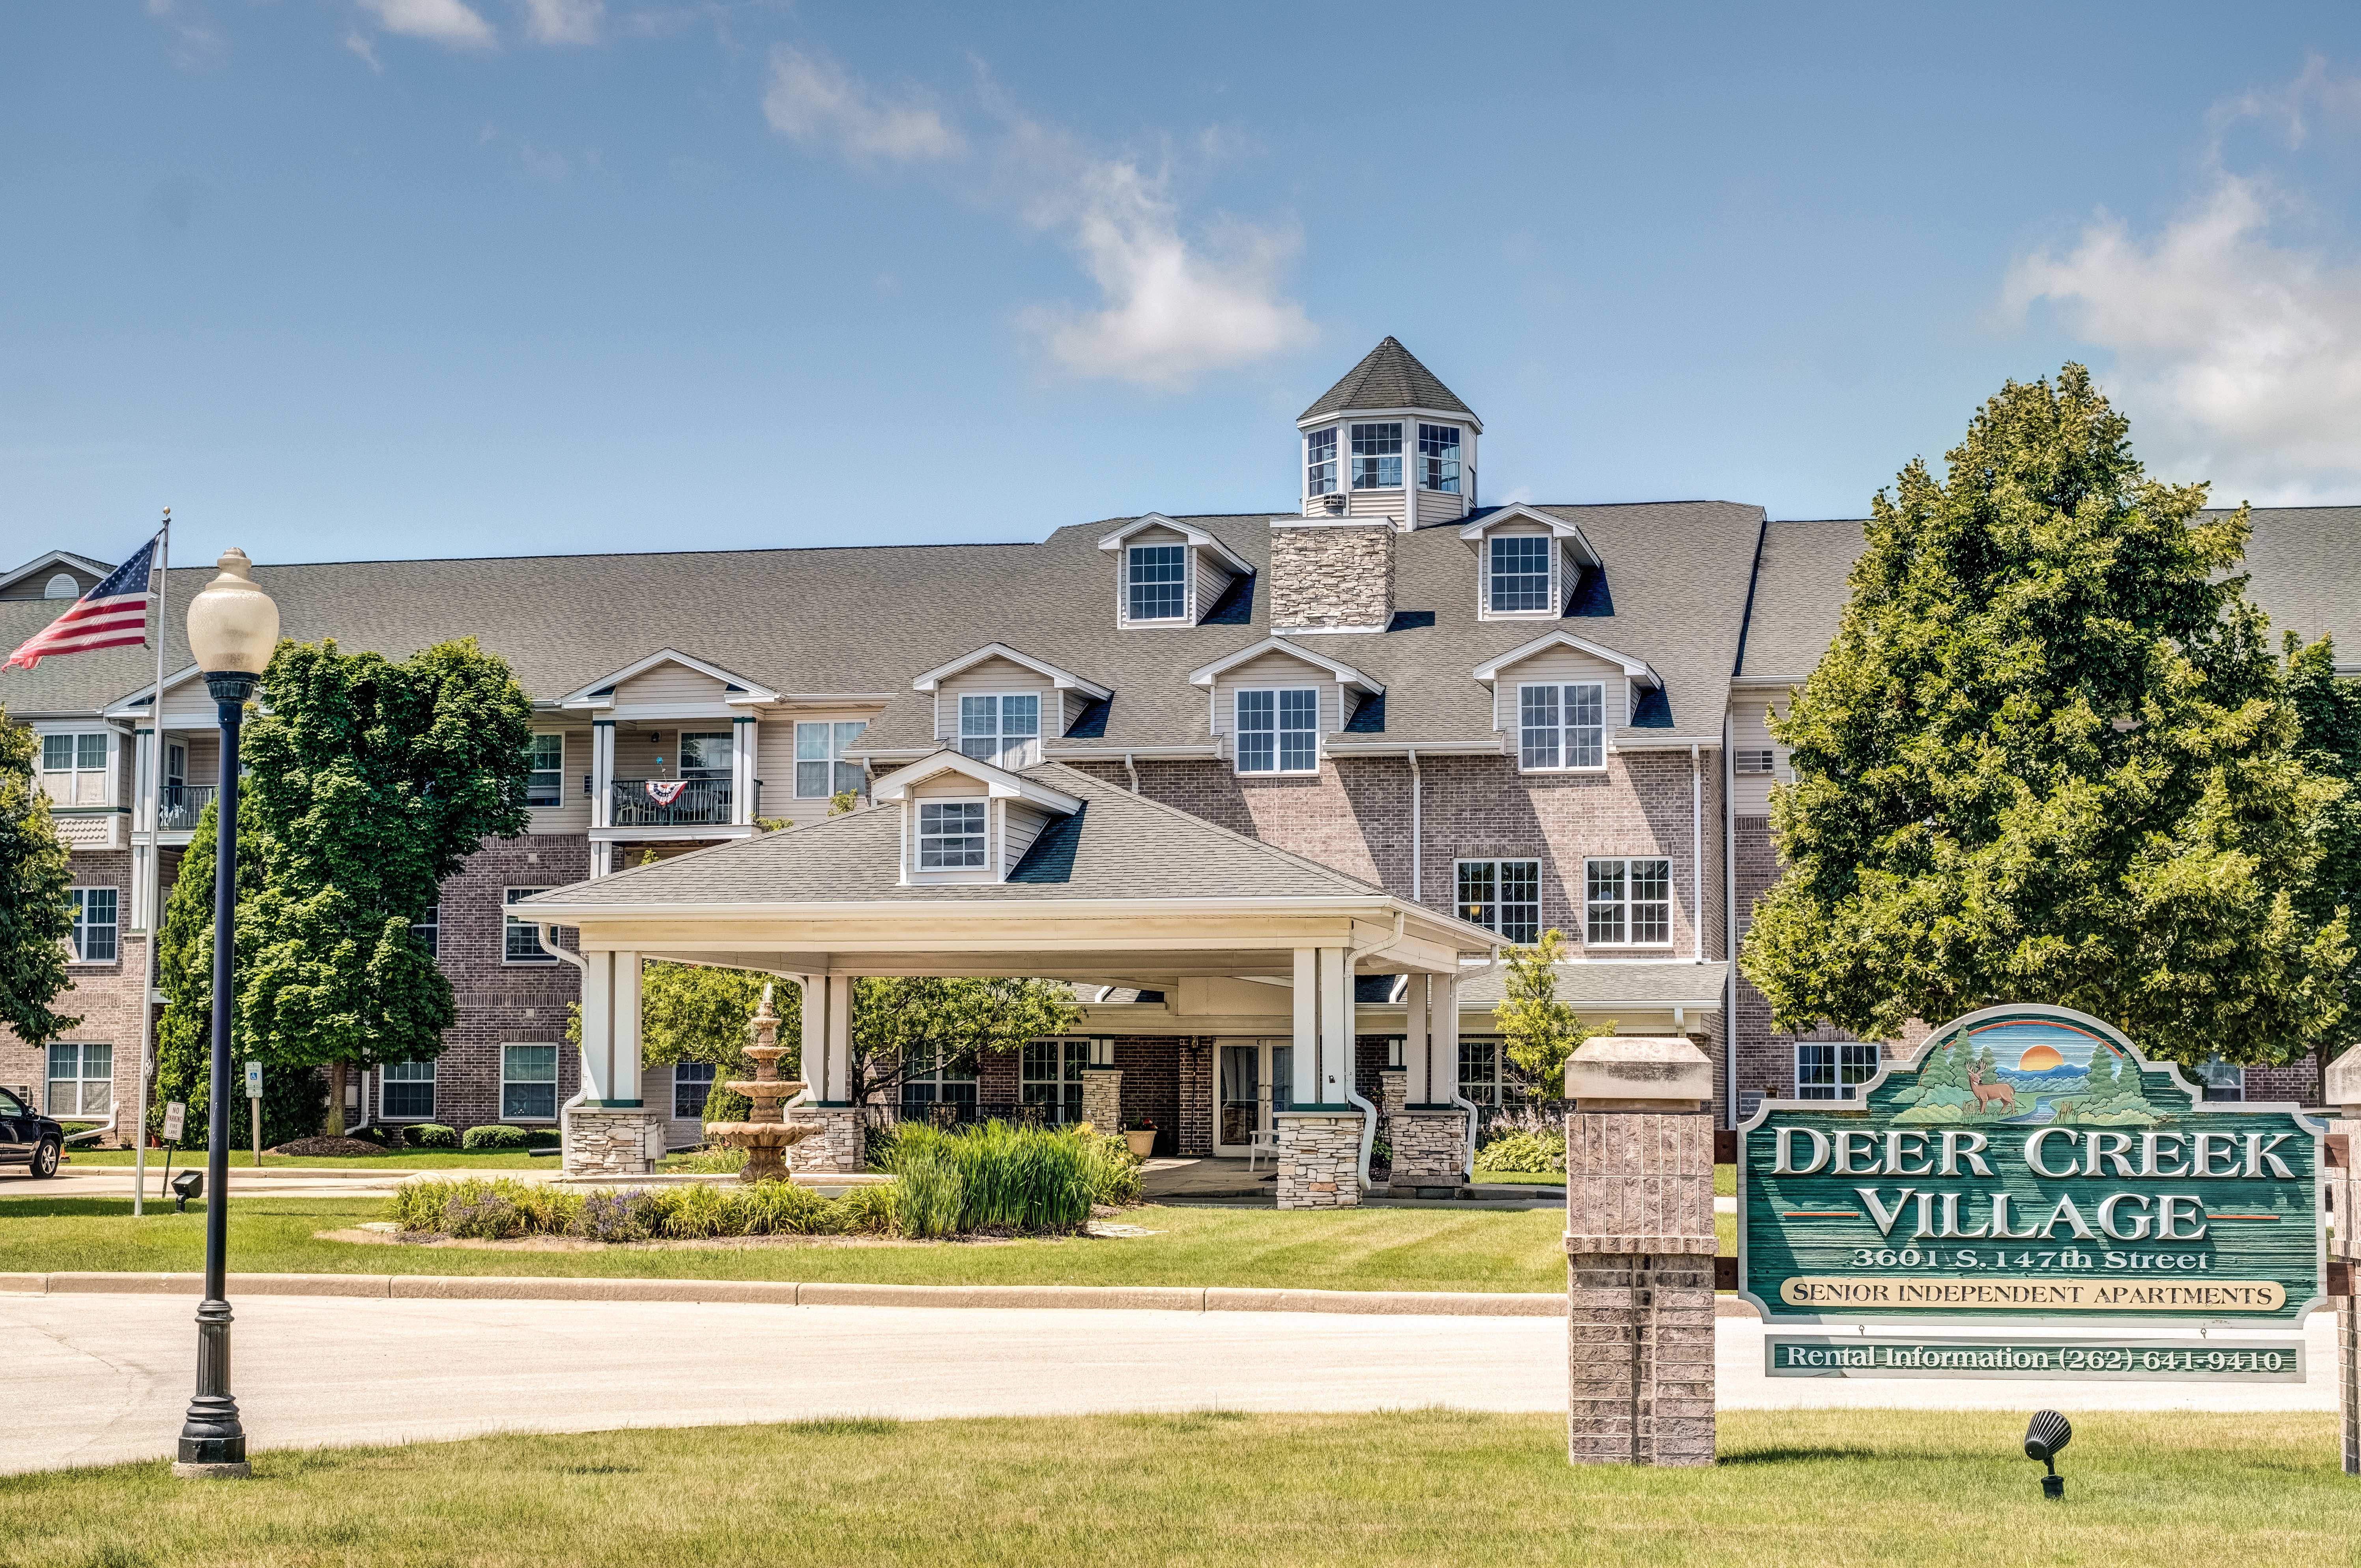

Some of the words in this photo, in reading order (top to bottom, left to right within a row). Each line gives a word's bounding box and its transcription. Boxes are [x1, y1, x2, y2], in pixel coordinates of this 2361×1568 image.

[167, 1115, 183, 1123] PARKING
[1771, 1127, 1994, 1175] DEER
[2024, 1128, 2295, 1177] CREEK
[1854, 1188, 2206, 1240] VILLAGE
[1853, 1249, 1939, 1267] 3601
[1955, 1250, 1986, 1267] S.
[1996, 1250, 2094, 1268] 147th
[2106, 1251, 2209, 1269] Street
[1793, 1284, 1890, 1301] SENIOR
[1899, 1284, 2084, 1303] INDEPENDENT
[2094, 1287, 2272, 1304] APARTMENTS
[1787, 1346, 1875, 1366] Rental
[1885, 1346, 2051, 1368] Information
[2059, 1347, 2133, 1371] (262)
[2143, 1351, 2282, 1371] 641-9410
